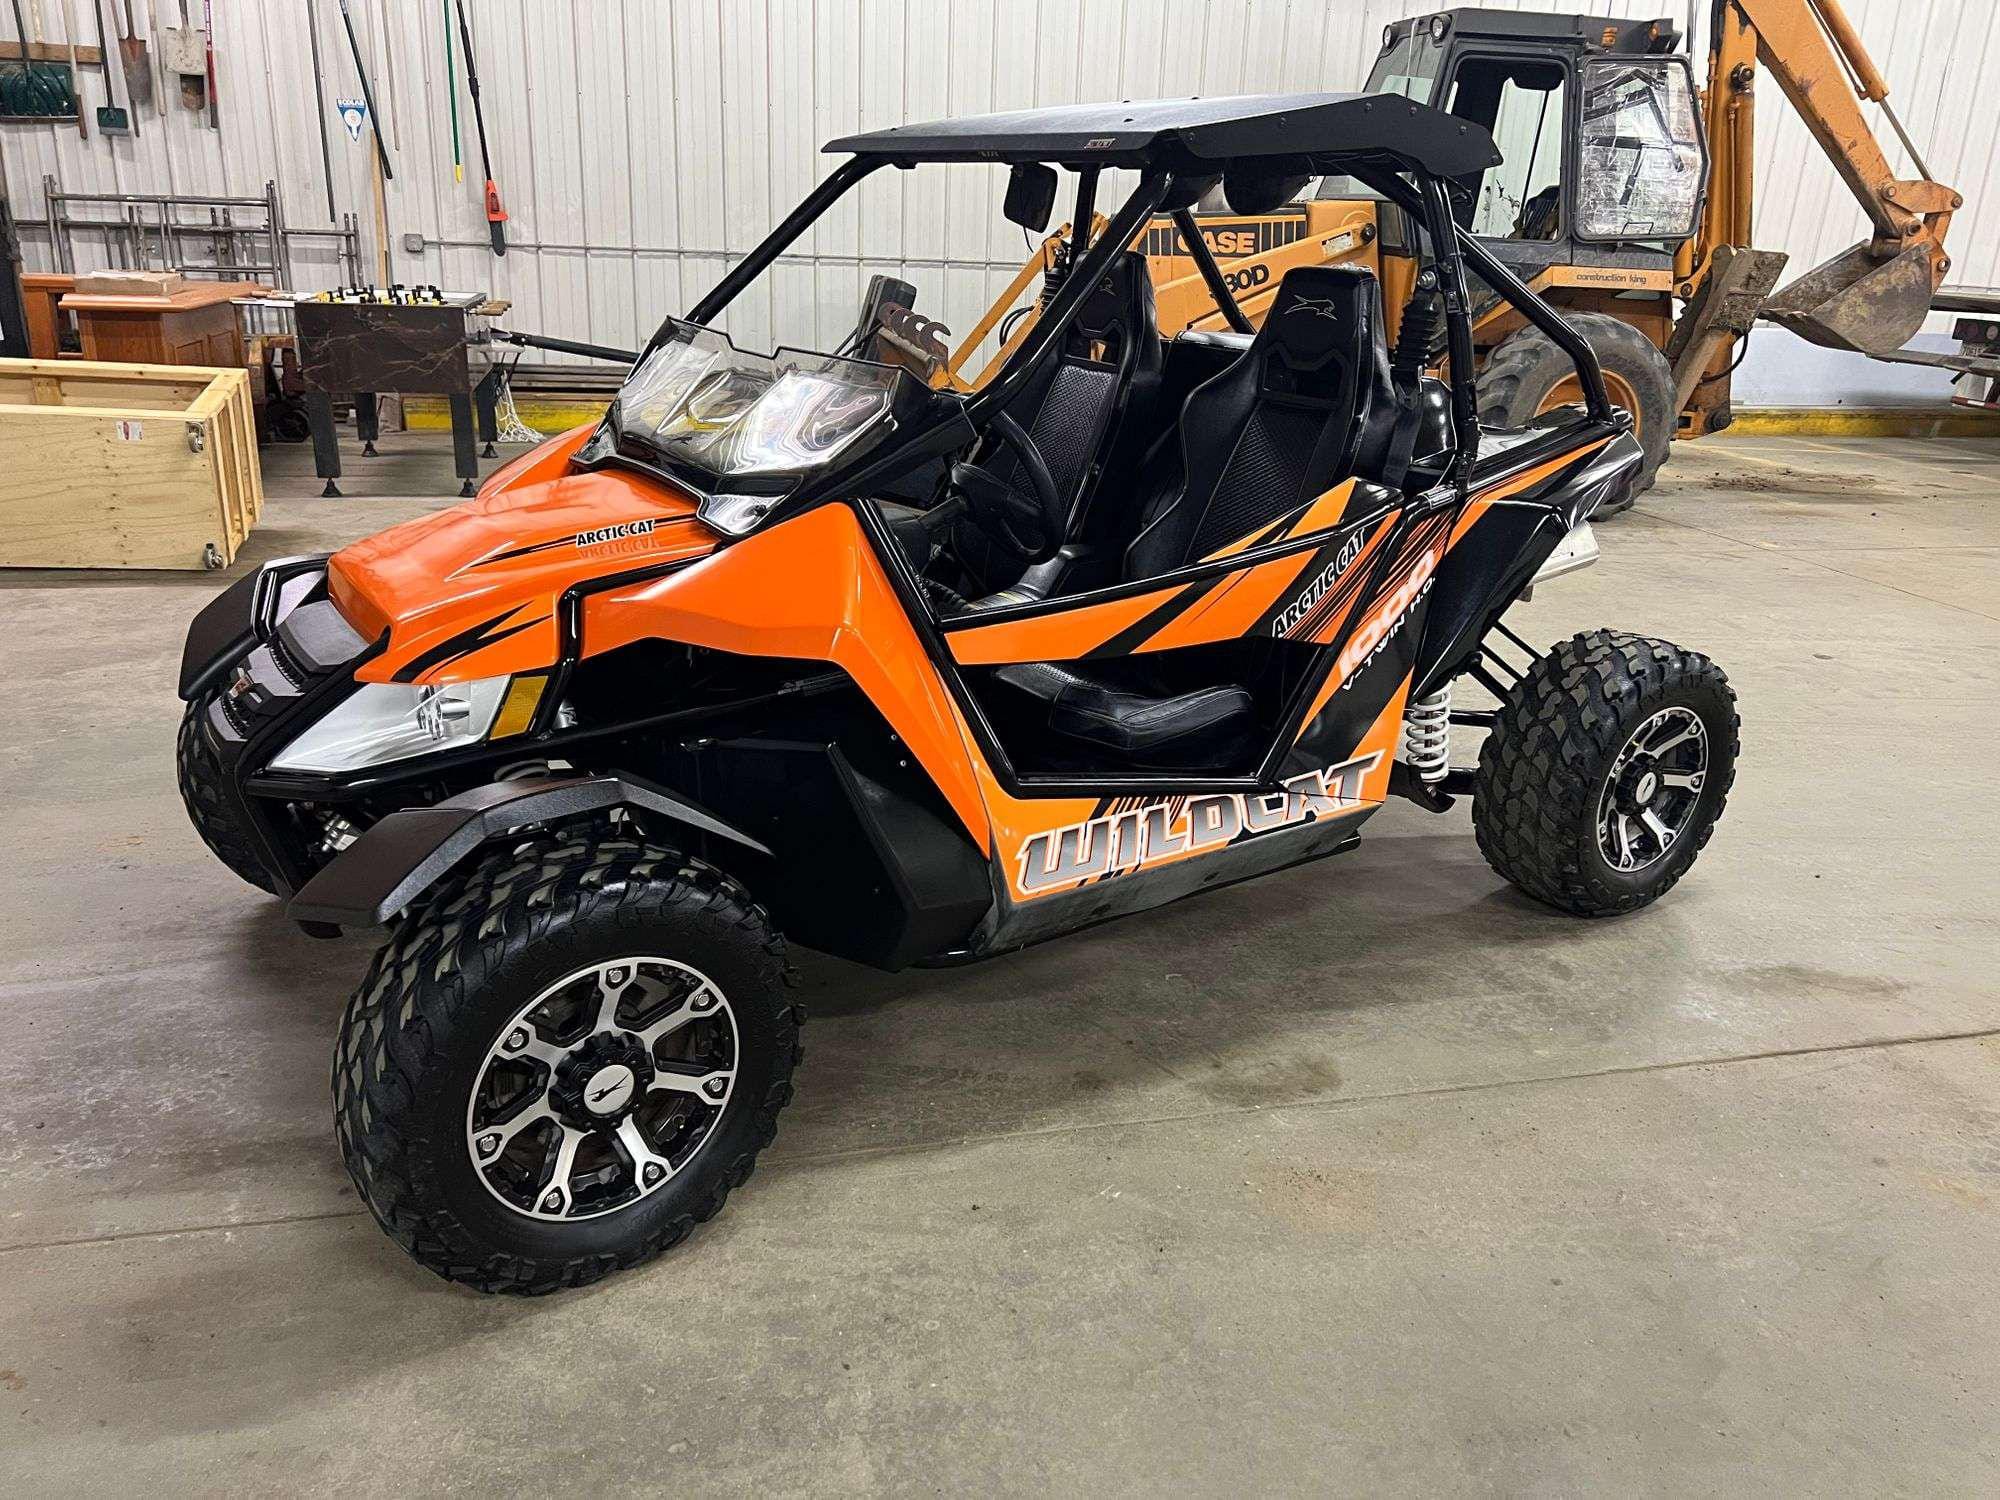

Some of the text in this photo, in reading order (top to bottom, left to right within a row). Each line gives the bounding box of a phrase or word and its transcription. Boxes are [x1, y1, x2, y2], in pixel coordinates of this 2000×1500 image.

[1576, 272, 1647, 284] construction king
[577, 519, 655, 546] ARCTIC CAT
[1271, 527, 1365, 638] ARCTIC CAT
[1338, 550, 1435, 682] 1000
[1342, 613, 1405, 690] V-TWIN
[1015, 749, 1386, 895] WILDCAT
